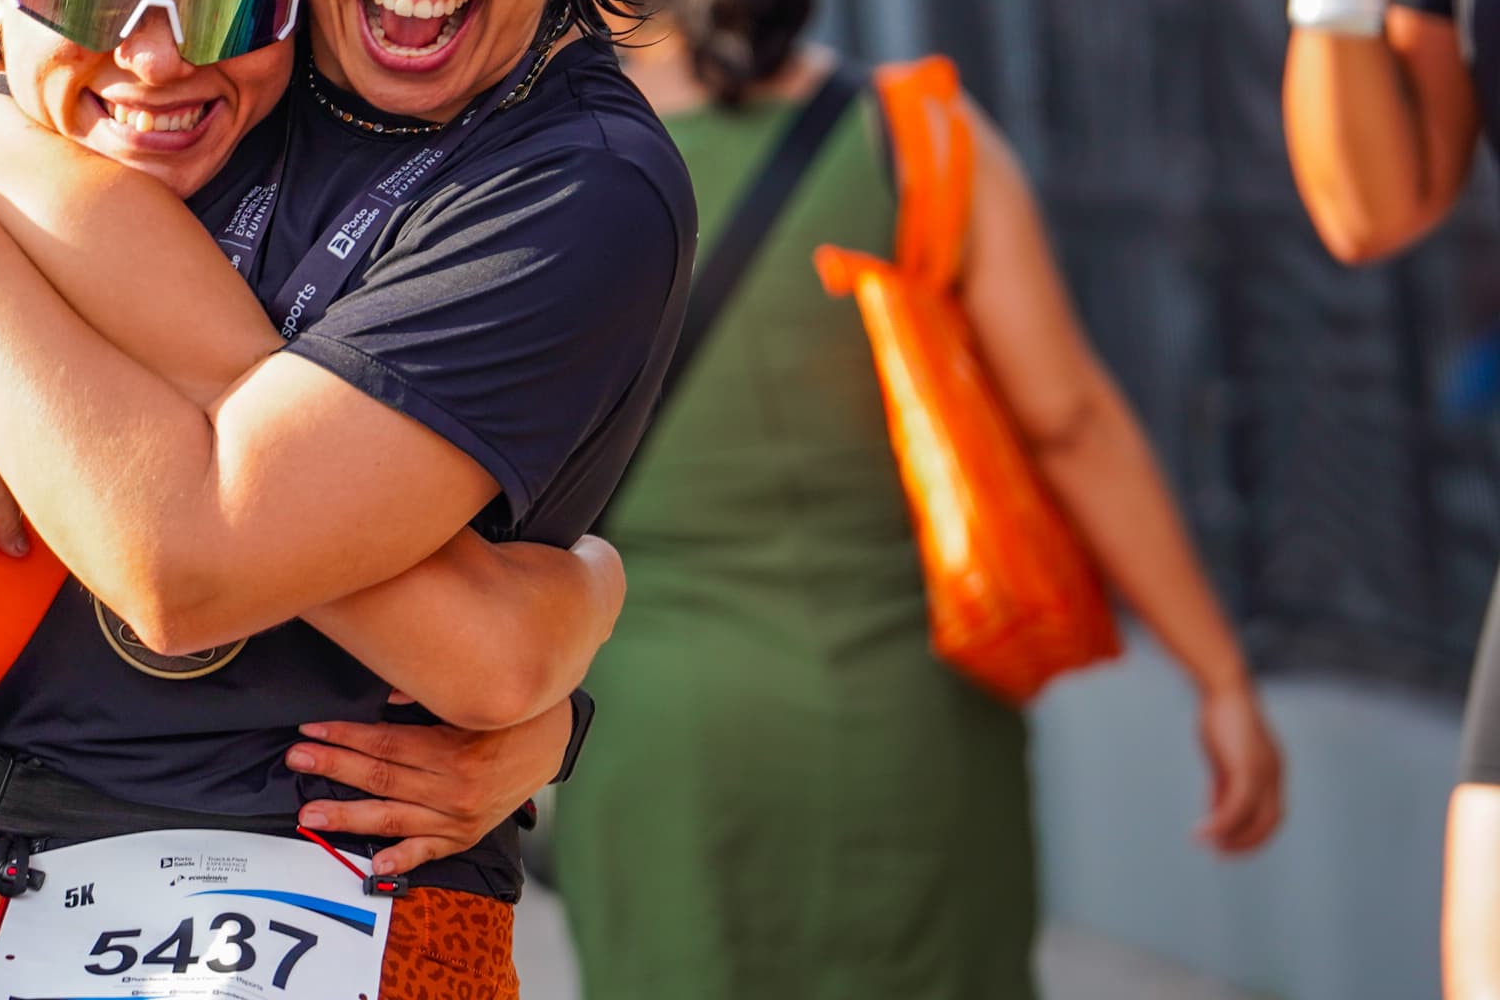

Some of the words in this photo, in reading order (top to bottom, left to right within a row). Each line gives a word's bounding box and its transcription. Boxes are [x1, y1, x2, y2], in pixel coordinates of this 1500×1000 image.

[393, 150, 444, 199] RUNNING
[245, 183, 278, 240] RUNNING
[341, 208, 368, 235] Porto
[351, 208, 380, 240] Saúde
[280, 283, 317, 339] sports
[64, 882, 95, 908] 5K
[84, 911, 319, 991] 5437
